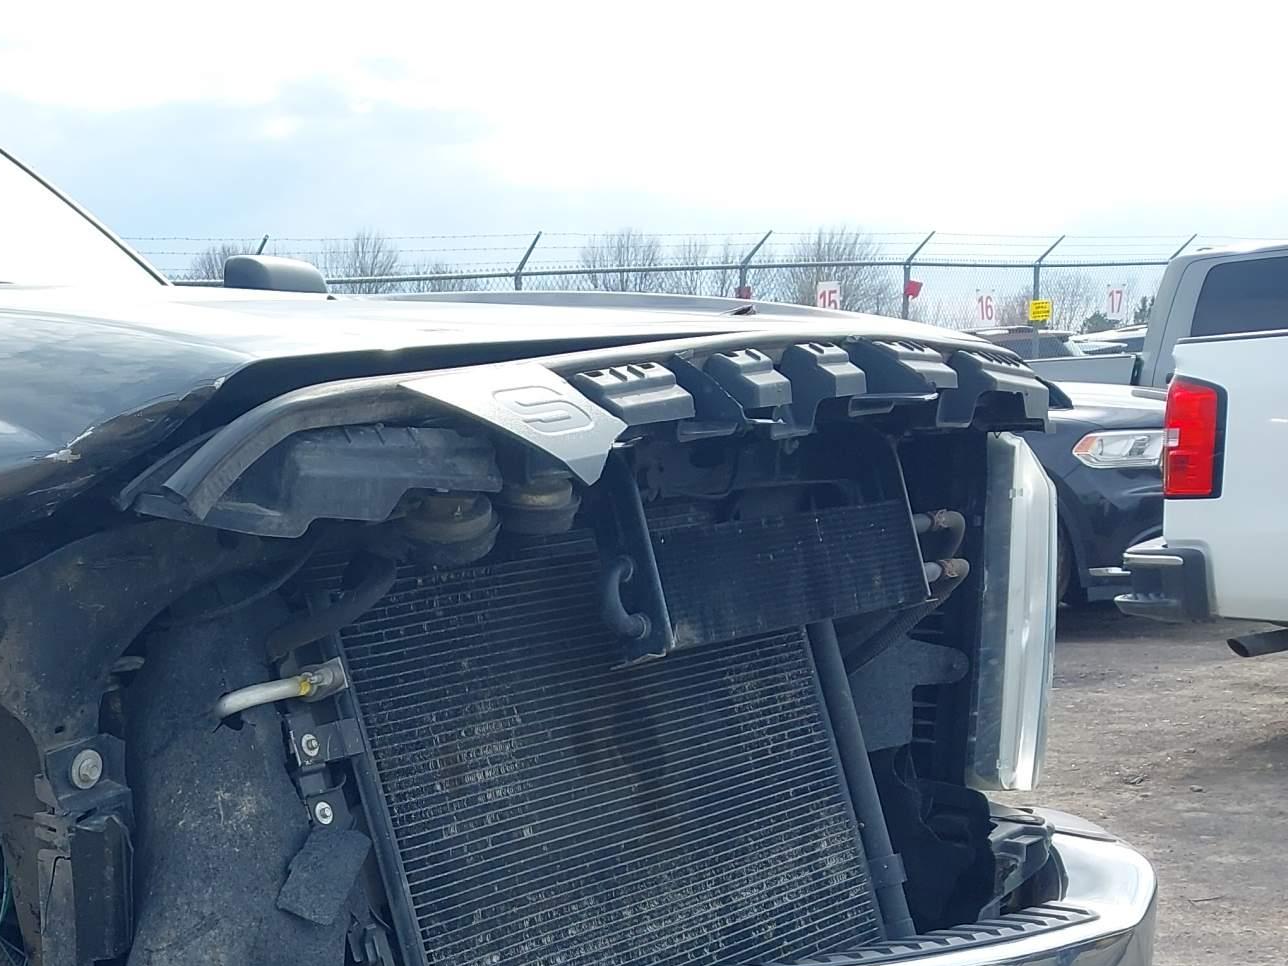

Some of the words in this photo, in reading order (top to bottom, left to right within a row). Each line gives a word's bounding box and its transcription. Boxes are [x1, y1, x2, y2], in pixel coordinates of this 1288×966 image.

[818, 289, 838, 309] 15
[977, 294, 995, 320] 16
[1107, 289, 1124, 314] 17
